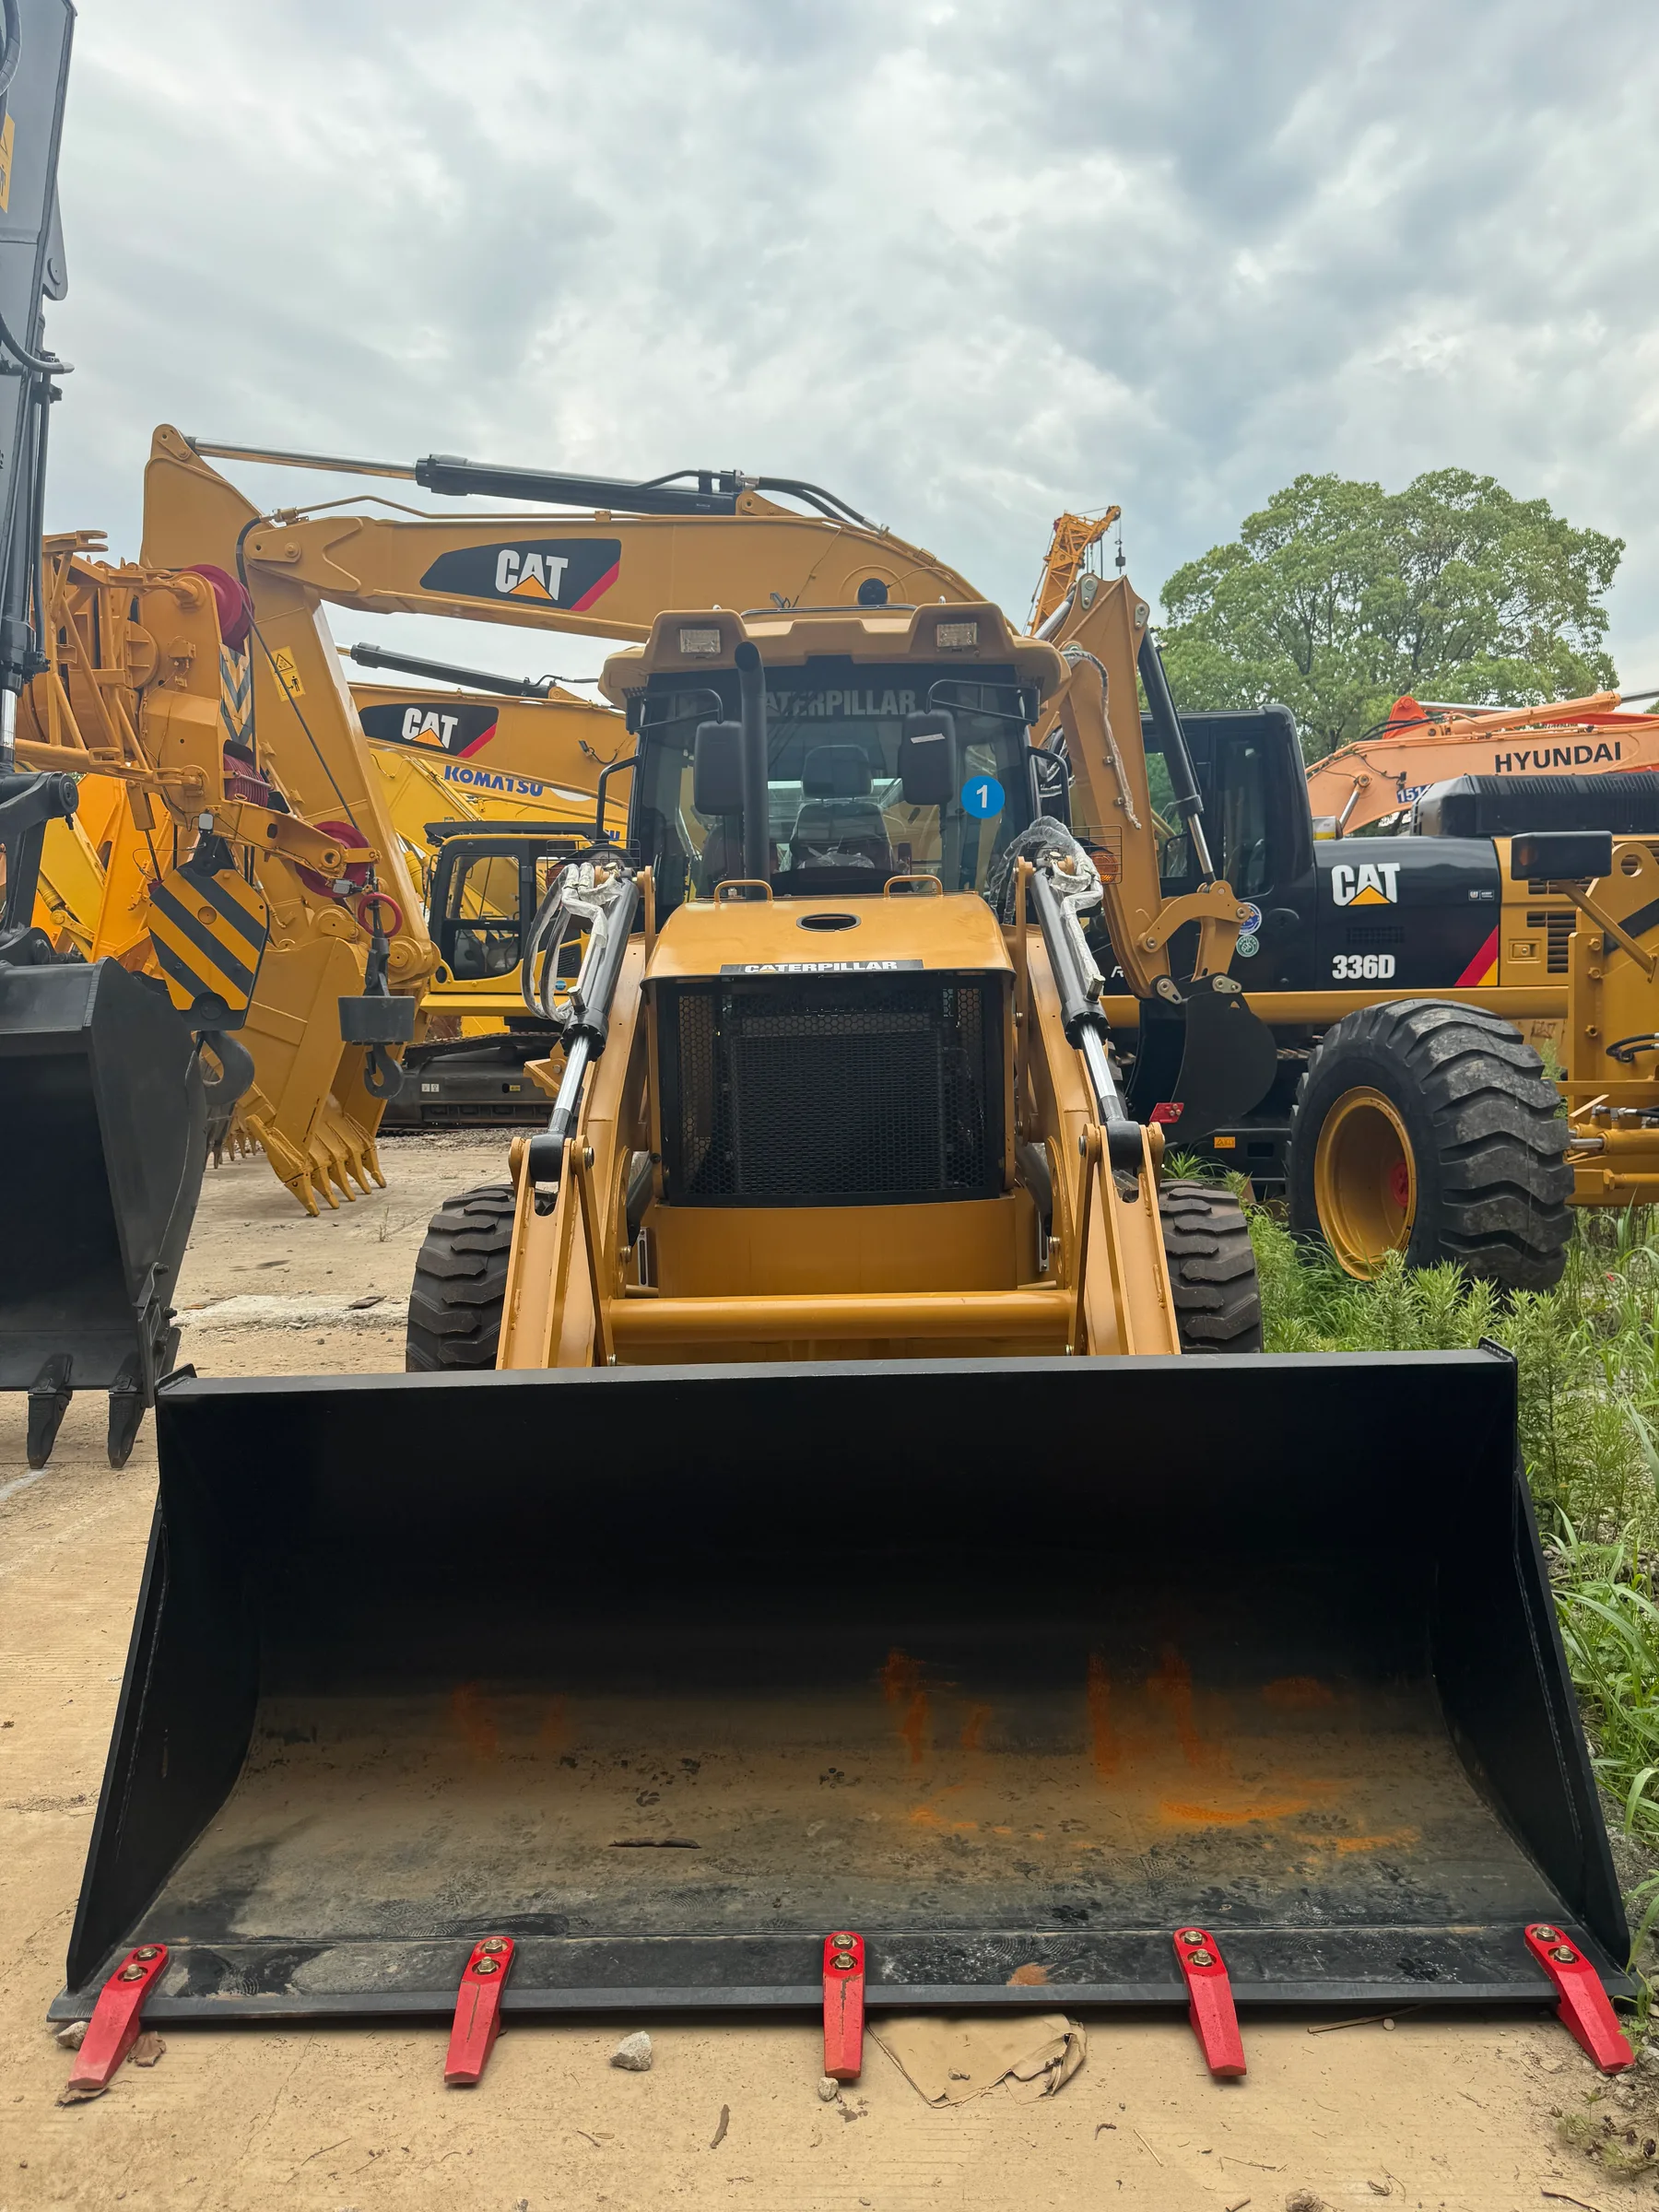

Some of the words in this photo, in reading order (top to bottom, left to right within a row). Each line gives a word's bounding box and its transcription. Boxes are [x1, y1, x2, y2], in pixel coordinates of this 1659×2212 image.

[495, 549, 569, 601] CAT
[766, 689, 915, 715] ATERPILLAR
[402, 708, 458, 749] CAT
[1495, 741, 1621, 772] HYUNDAI
[444, 765, 544, 797] KOMATSU
[976, 784, 988, 808] 1
[1331, 863, 1401, 906] CAT
[744, 961, 898, 973] CATERPILLAR
[1332, 954, 1395, 980] 336D
